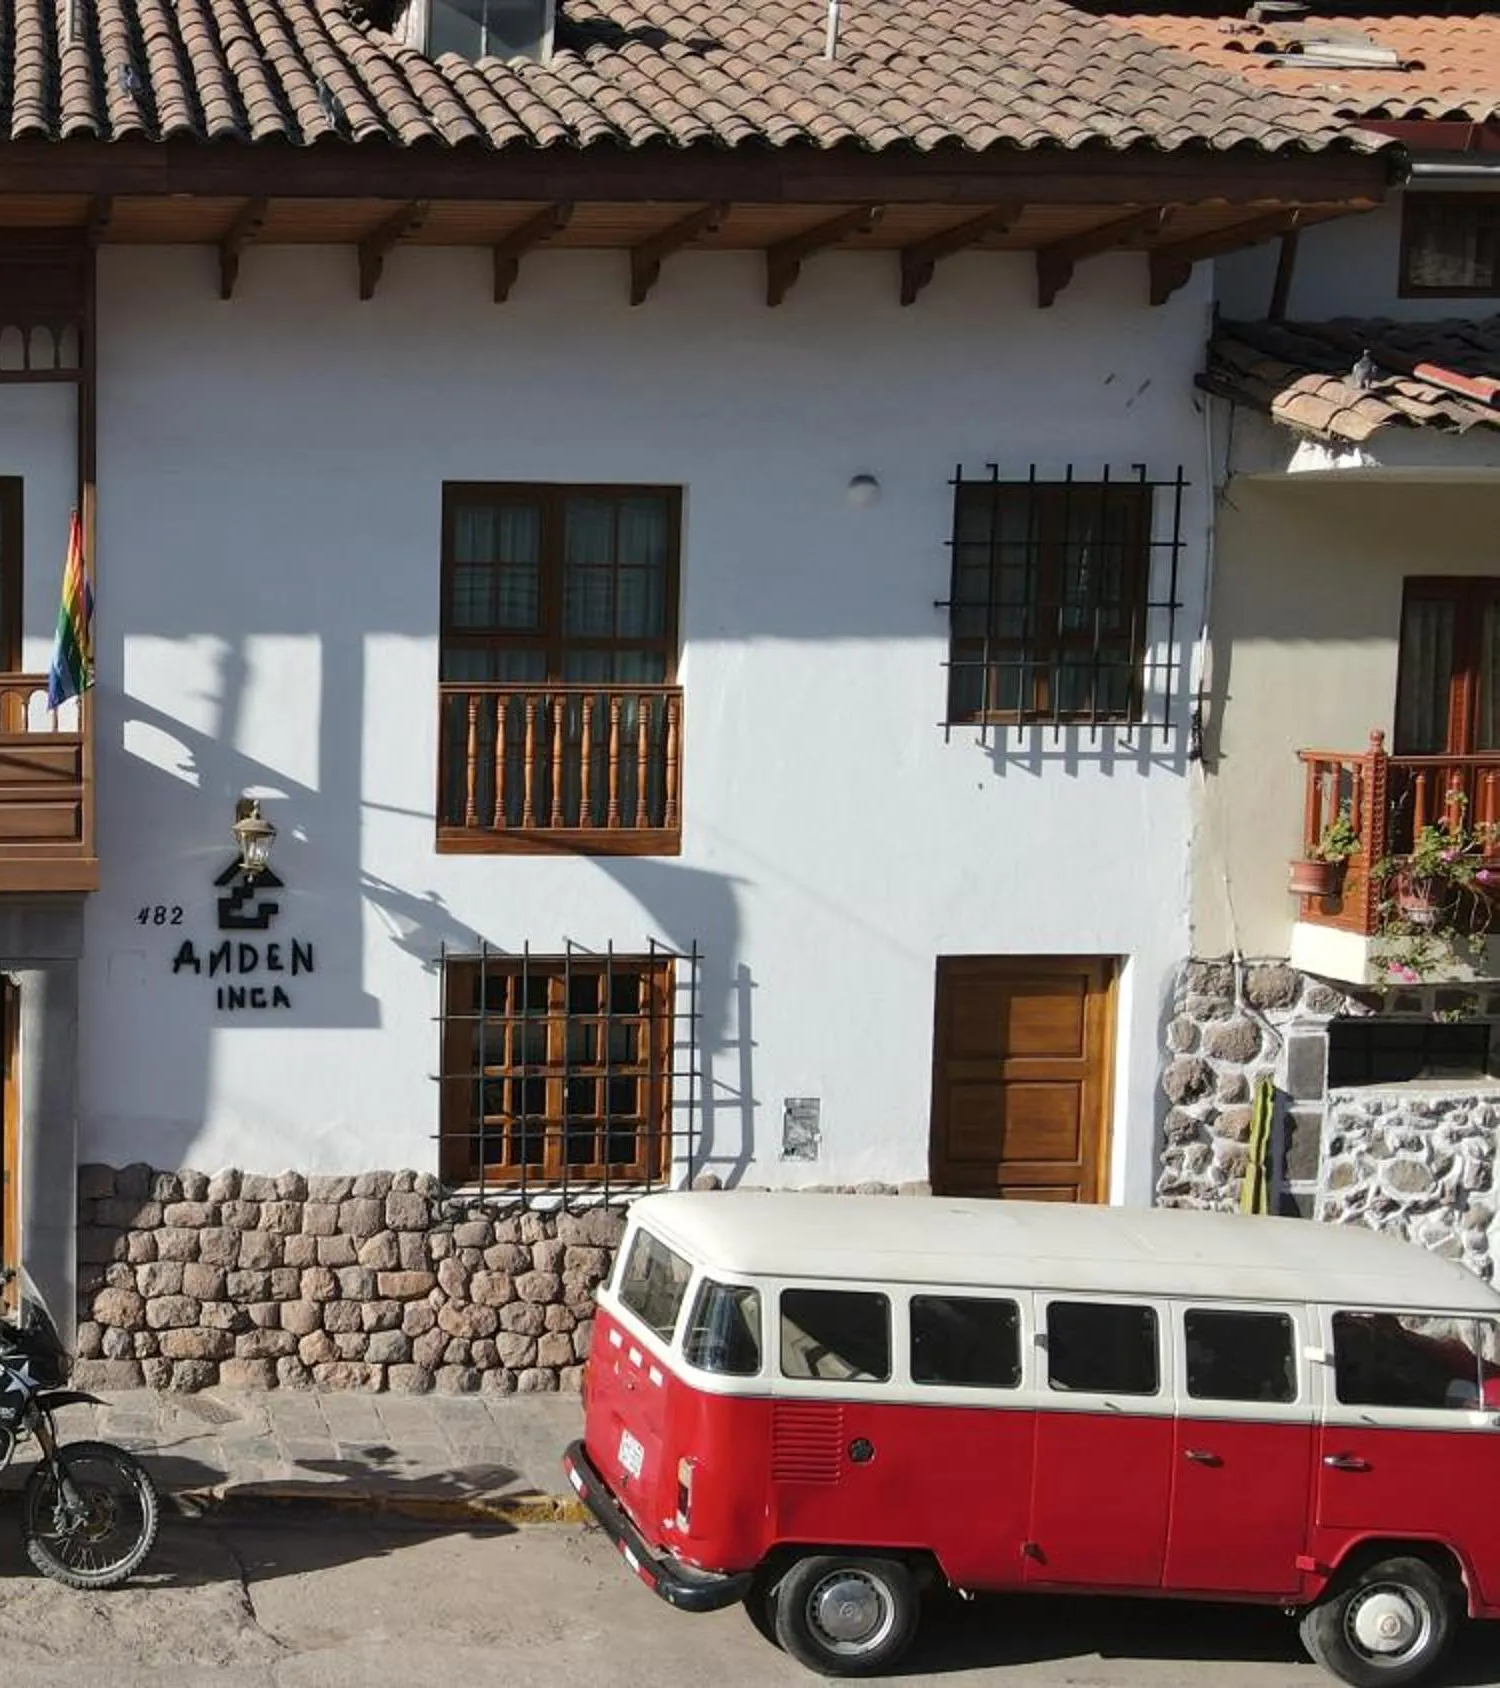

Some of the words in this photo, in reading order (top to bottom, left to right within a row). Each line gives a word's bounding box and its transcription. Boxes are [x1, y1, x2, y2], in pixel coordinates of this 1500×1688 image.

[135, 905, 184, 925] 482
[172, 938, 314, 977] ANDEN
[216, 985, 291, 1010] INCA
